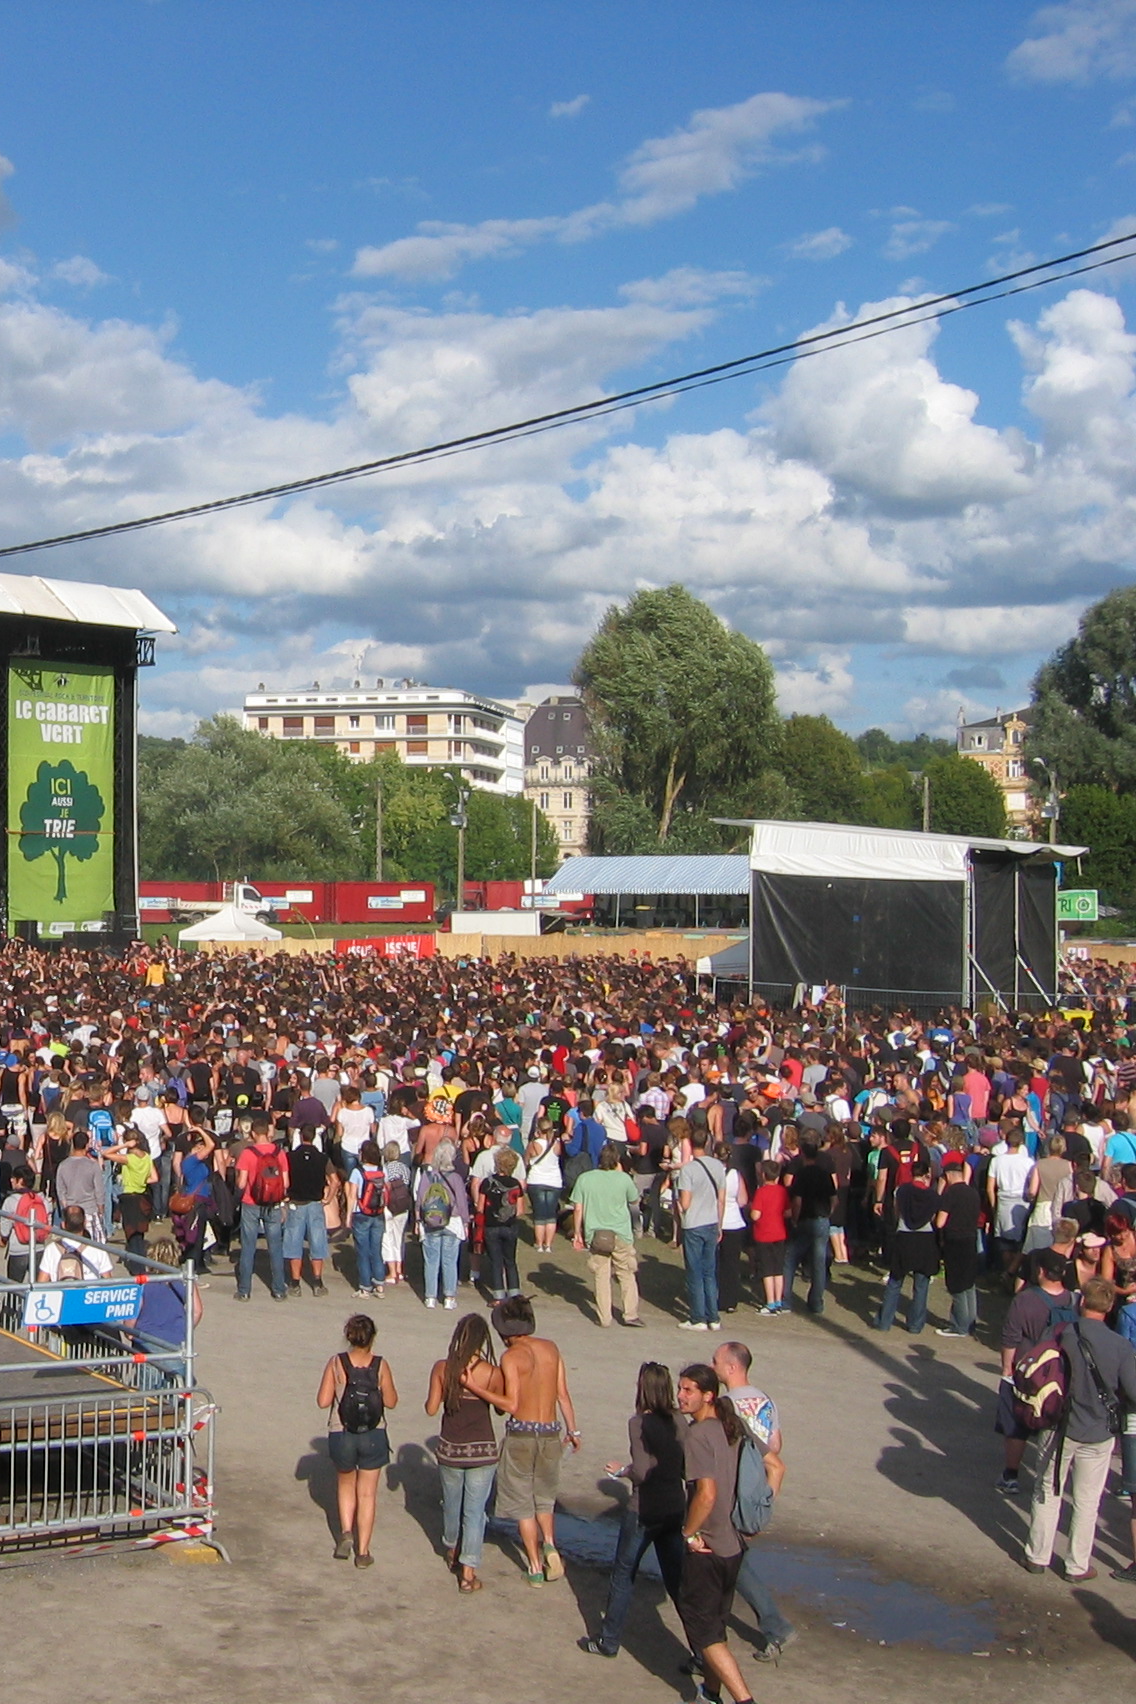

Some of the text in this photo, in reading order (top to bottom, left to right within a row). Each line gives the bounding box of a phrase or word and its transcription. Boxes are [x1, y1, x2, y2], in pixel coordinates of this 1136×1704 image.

[50, 778, 71, 795] ICI
[51, 797, 73, 806] AUSSI
[59, 808, 69, 818] JE
[44, 819, 75, 838] TRIE
[1058, 898, 1072, 912] RI
[84, 1287, 138, 1305] SERVICE
[105, 1303, 135, 1318] PMR
